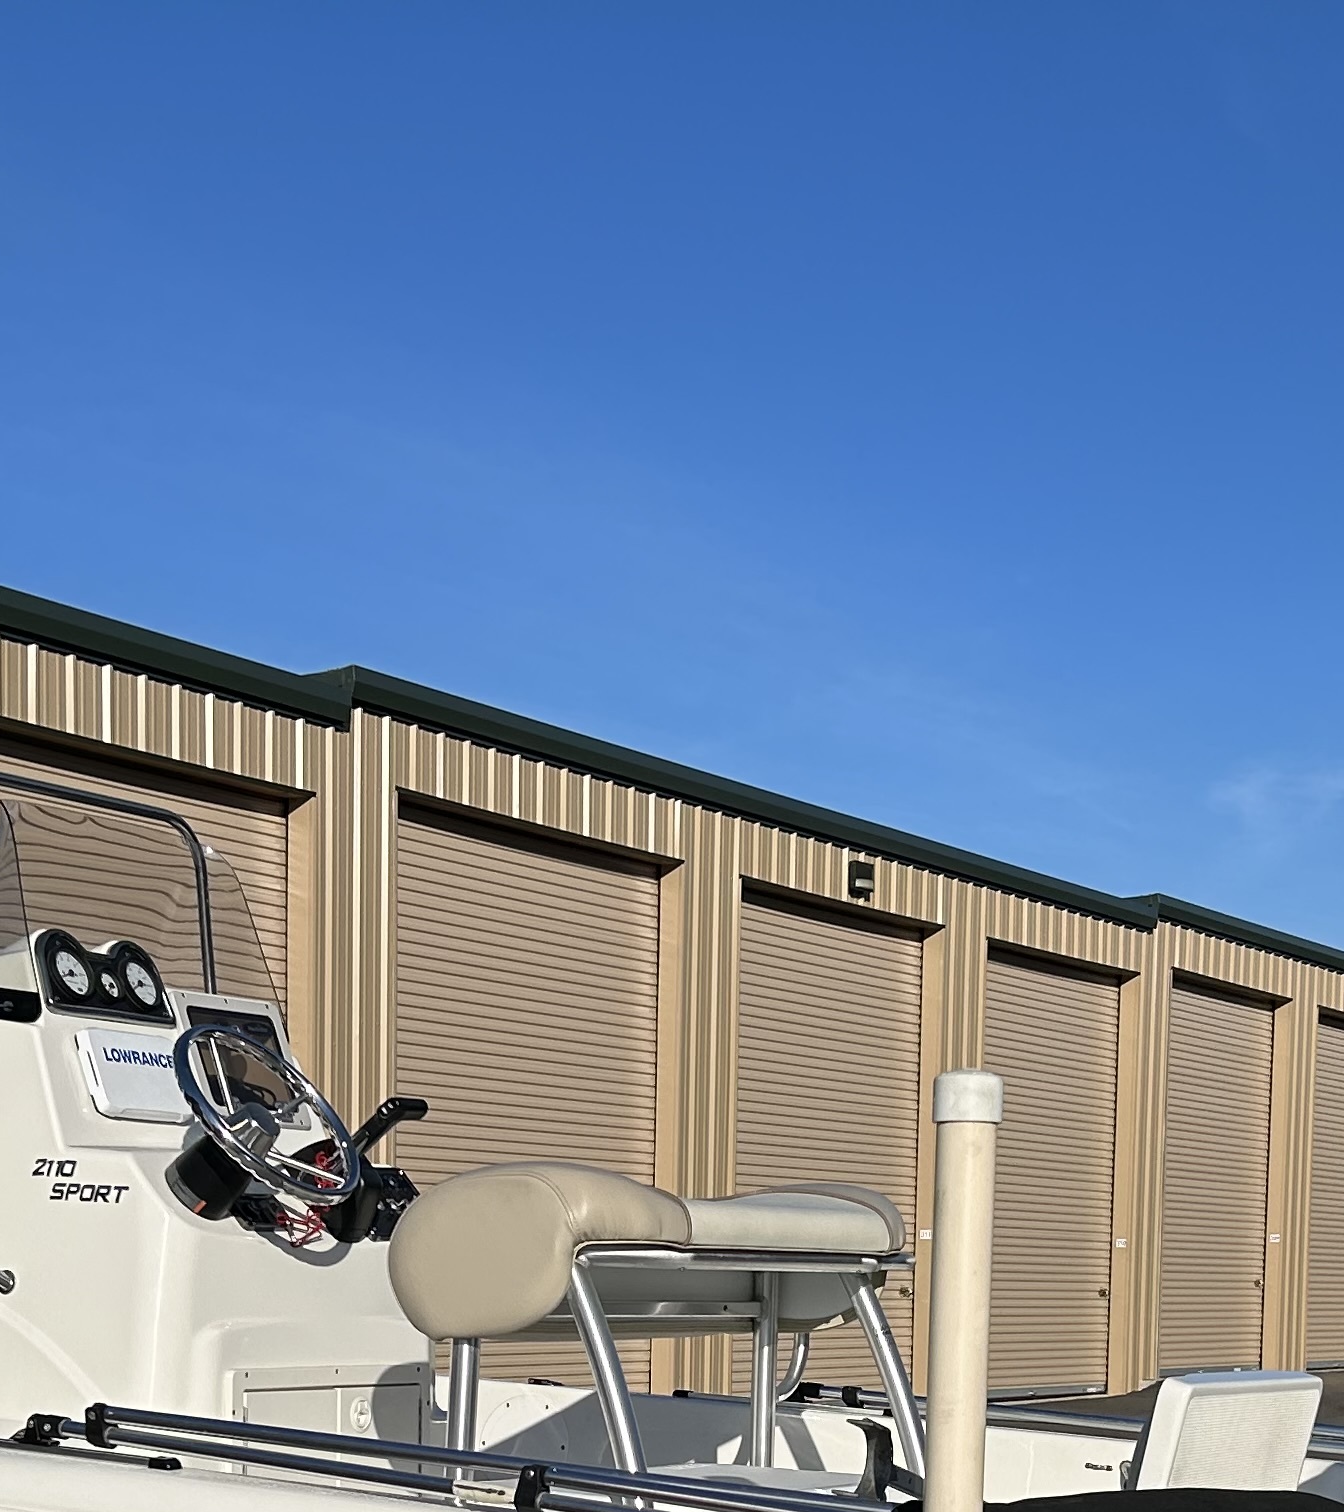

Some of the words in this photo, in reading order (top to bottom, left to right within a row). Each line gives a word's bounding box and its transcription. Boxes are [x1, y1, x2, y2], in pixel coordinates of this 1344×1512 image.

[102, 1047, 174, 1069] LOWRANCE
[31, 1158, 77, 1178] 2110
[49, 1182, 130, 1204] SPORT
